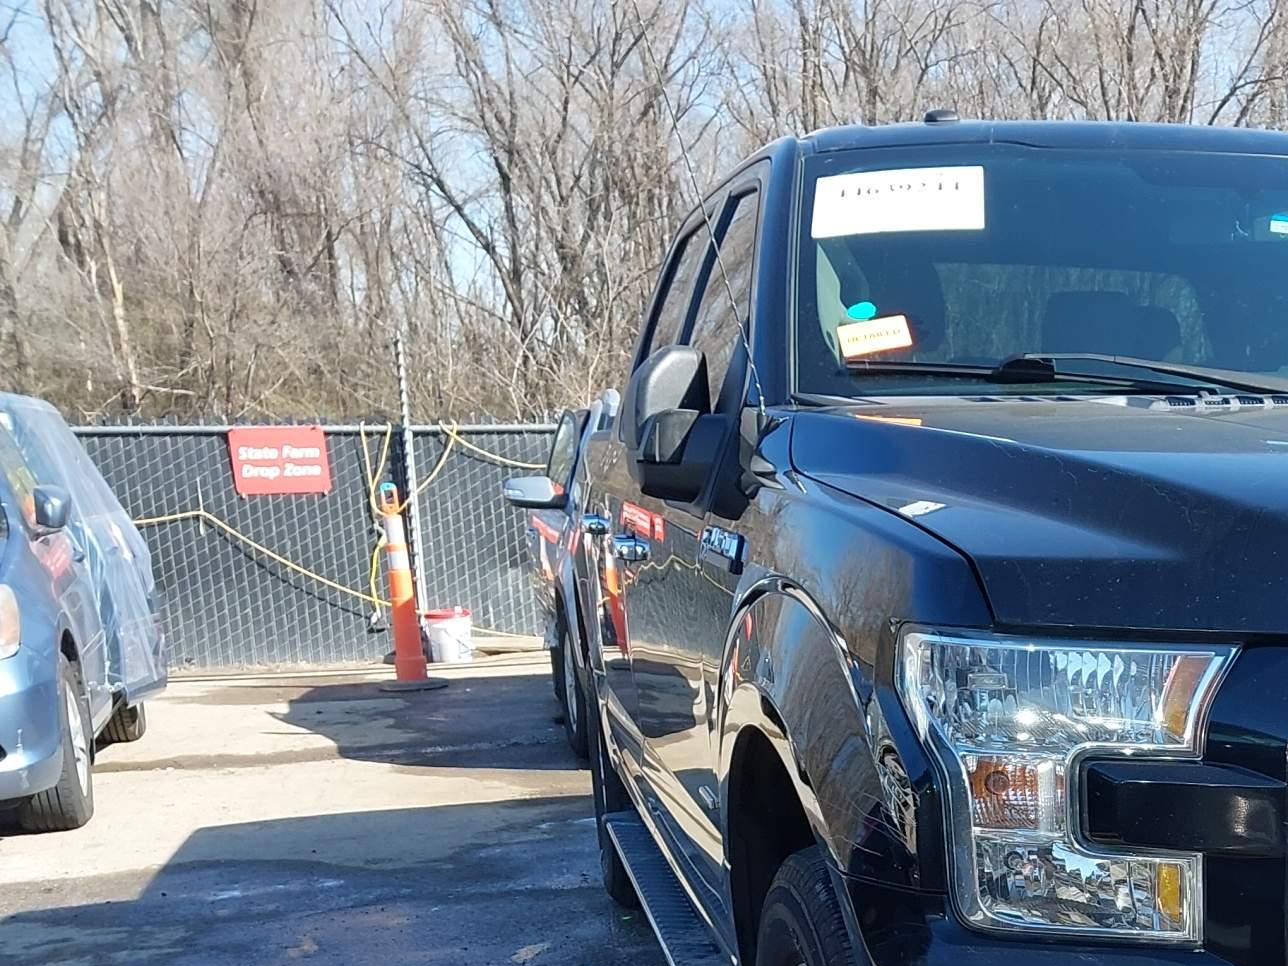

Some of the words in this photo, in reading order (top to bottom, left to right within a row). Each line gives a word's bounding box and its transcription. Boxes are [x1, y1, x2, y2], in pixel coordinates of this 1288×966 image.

[238, 446, 278, 460] State
[282, 445, 320, 458] Farm
[242, 464, 280, 480] Drop
[283, 463, 321, 477] Zone
